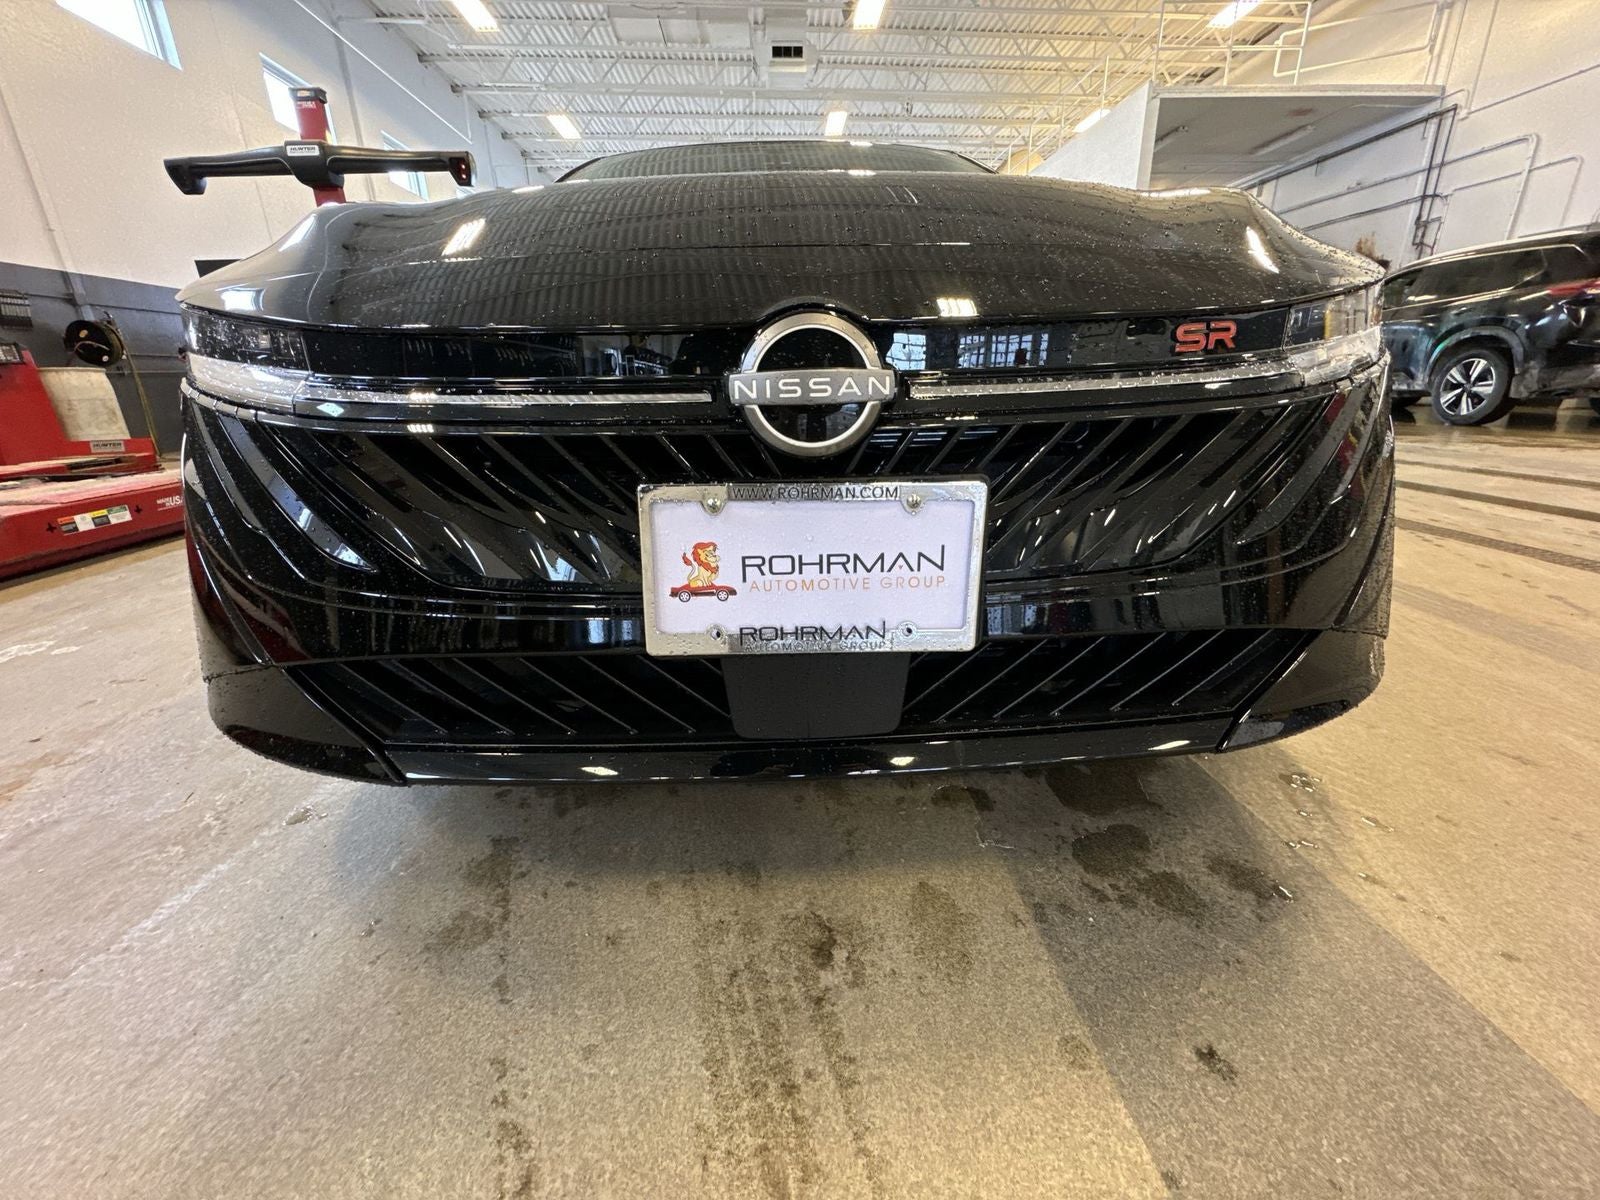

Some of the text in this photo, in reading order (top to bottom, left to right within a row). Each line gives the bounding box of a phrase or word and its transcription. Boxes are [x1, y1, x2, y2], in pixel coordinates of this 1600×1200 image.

[1175, 320, 1237, 352] SR
[734, 376, 890, 399] NISSAN
[732, 486, 899, 499] WWW.ROHRMAN.COM
[741, 544, 945, 583] ROHRMAN
[749, 575, 945, 593] AUTOMOTIVE GROUP
[739, 620, 886, 646] ROHRMAN
[839, 640, 886, 651] GROUP
